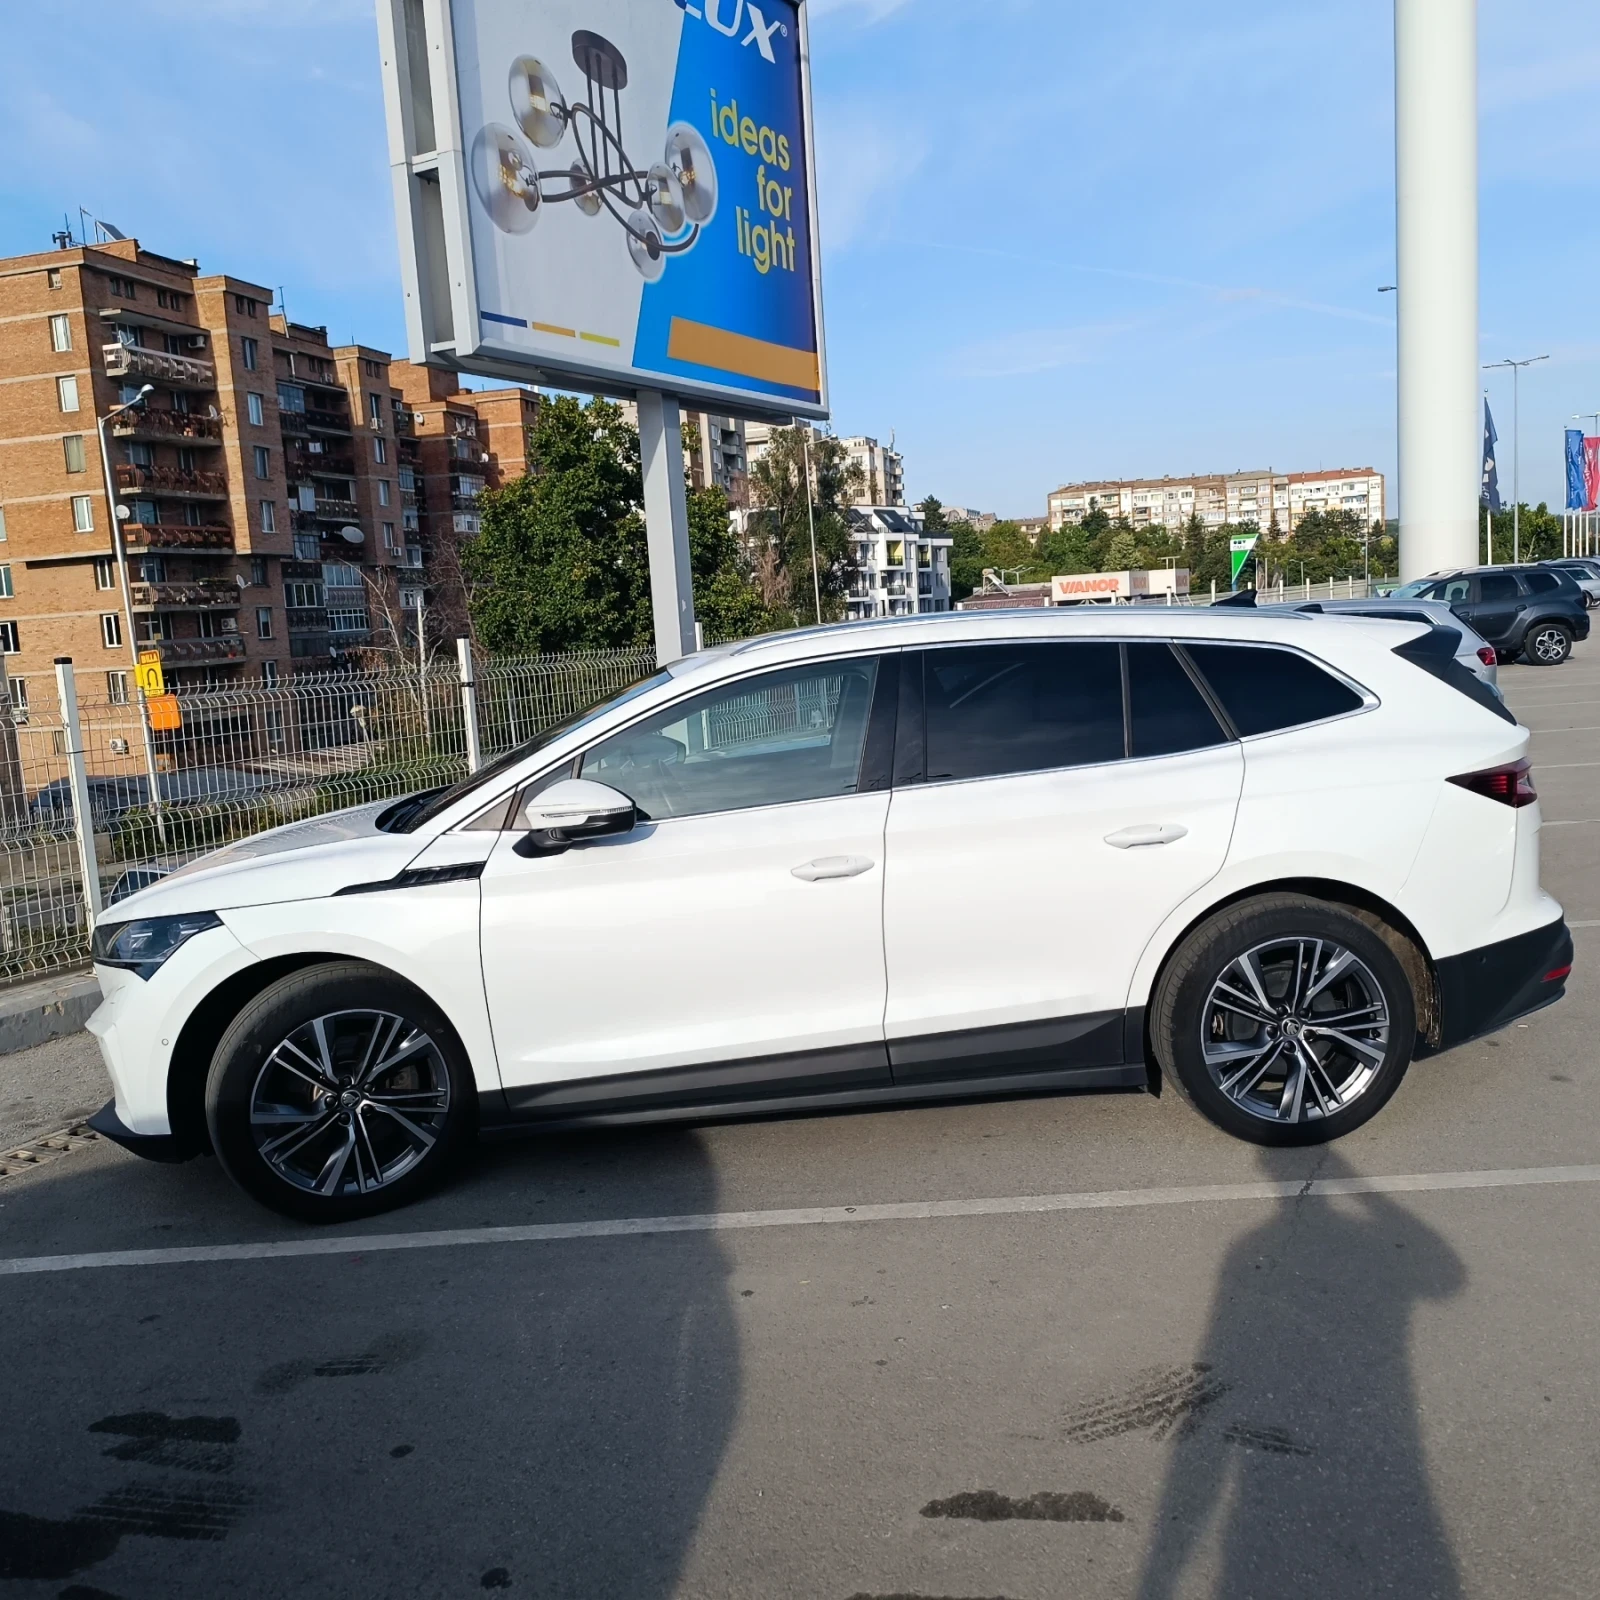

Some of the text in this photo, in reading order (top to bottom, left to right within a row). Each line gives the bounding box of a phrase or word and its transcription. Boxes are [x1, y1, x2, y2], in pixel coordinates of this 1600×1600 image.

[672, 0, 781, 64] UX
[709, 87, 791, 172] ideas
[756, 165, 792, 221] for
[735, 205, 795, 274] light
